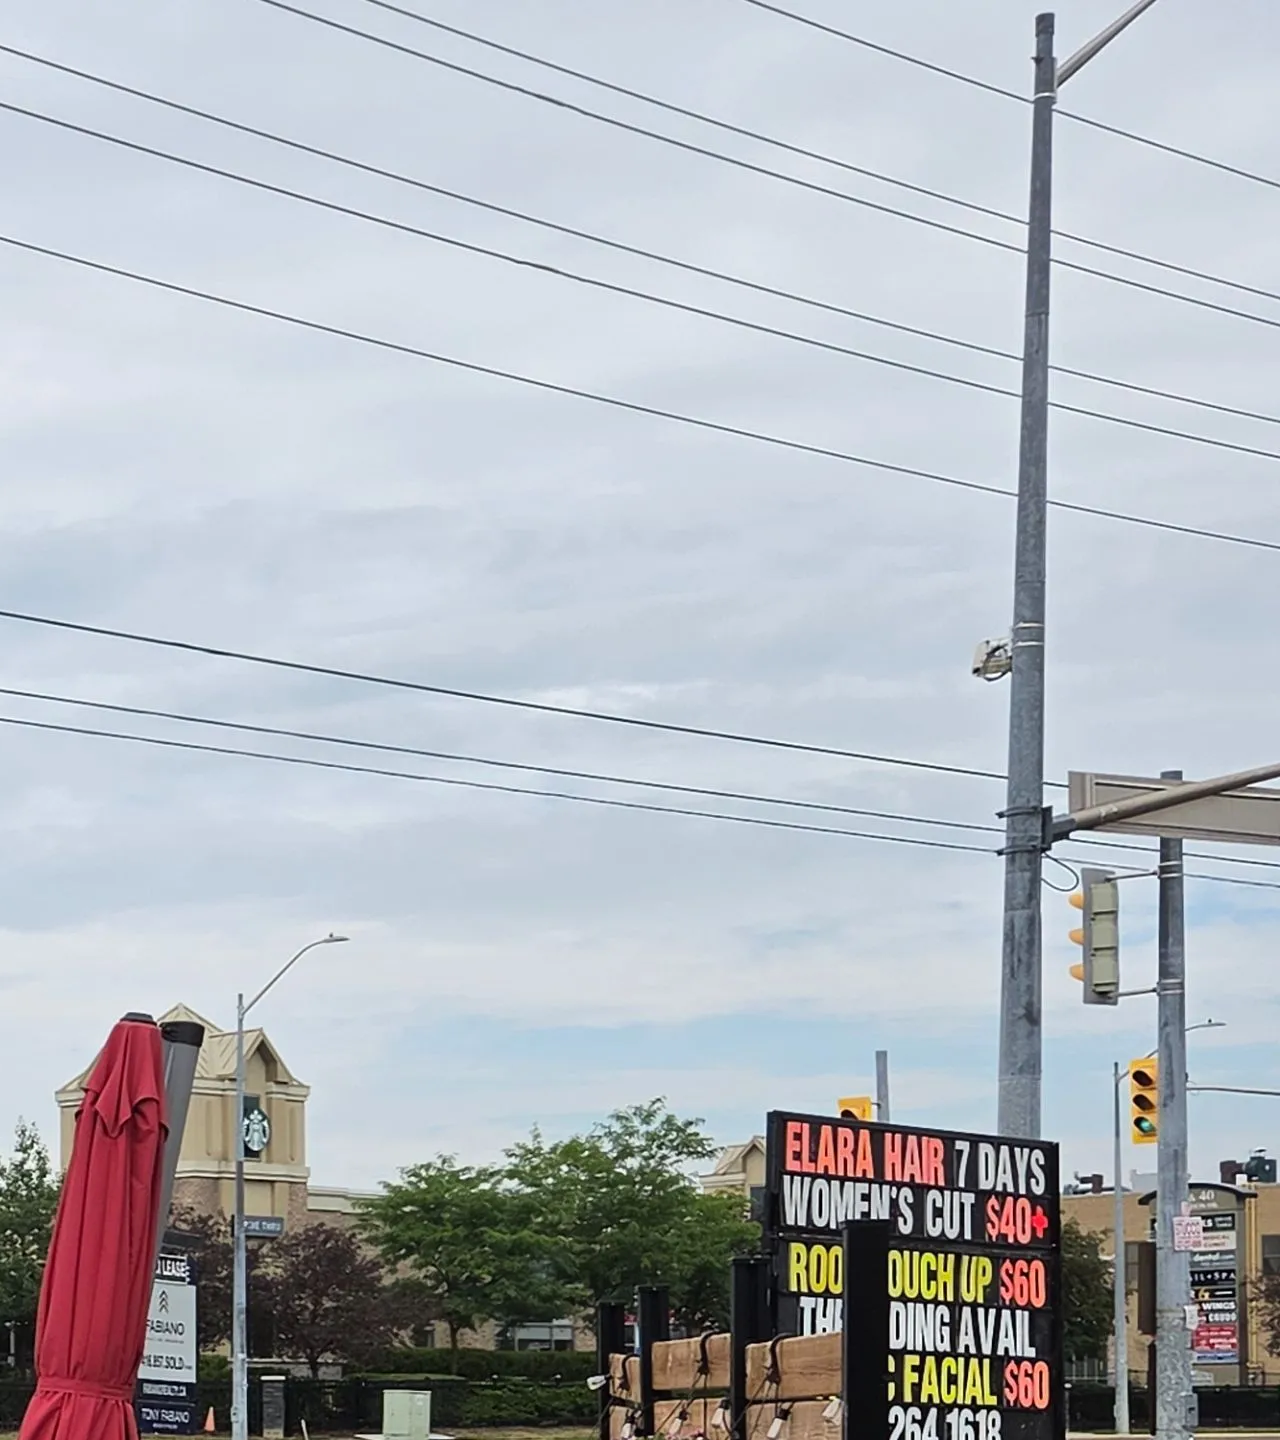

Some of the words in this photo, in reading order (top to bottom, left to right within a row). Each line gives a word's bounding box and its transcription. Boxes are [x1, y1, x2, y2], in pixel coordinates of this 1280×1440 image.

[785, 1121, 874, 1179] ELARA
[884, 1132, 945, 1186] HAIR
[955, 1140, 970, 1188] 7
[978, 1142, 1045, 1195] DAYS
[783, 1175, 913, 1235] WOMEN'S
[926, 1189, 975, 1240] CUT
[789, 1242, 843, 1294] ROO
[888, 1250, 954, 1301] OUCH
[960, 1255, 992, 1303] UP
[1000, 1258, 1046, 1308] $60
[957, 1306, 1036, 1357] AVAIL
[1202, 1302, 1235, 1310] WINGS
[903, 1355, 998, 1406] FACIAL
[1004, 1360, 1049, 1409] $60
